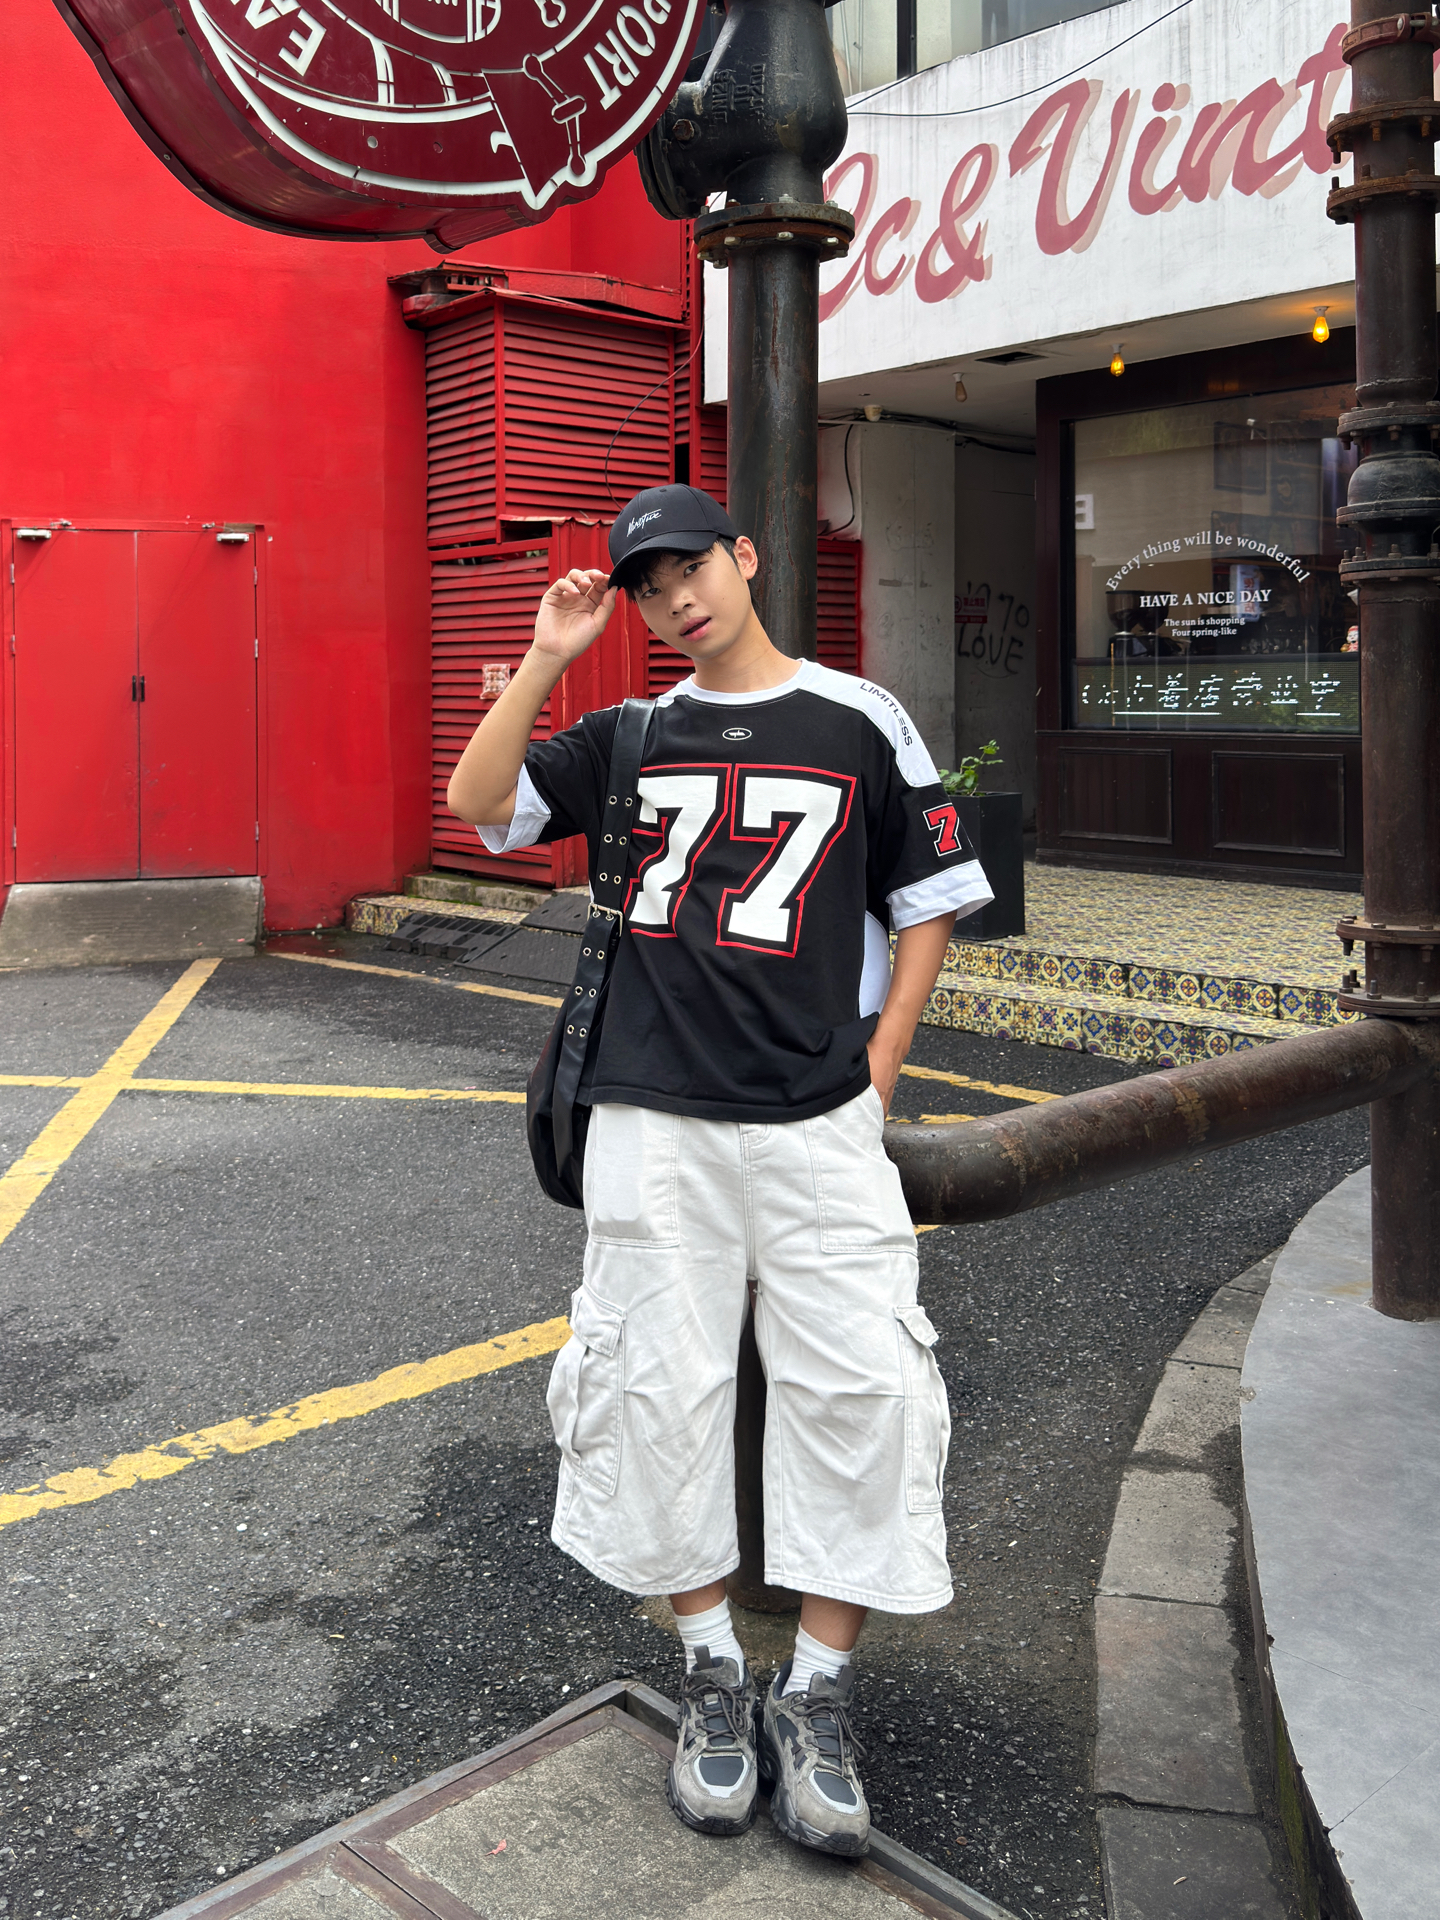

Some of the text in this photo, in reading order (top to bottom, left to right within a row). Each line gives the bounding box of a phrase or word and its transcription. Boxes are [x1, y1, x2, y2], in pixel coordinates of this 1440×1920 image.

[231, 0, 327, 77] EA
[915, 143, 999, 304] &
[1009, 22, 1353, 256] Vint
[1105, 531, 1311, 591] Every thing will be wonderful
[1139, 589, 1272, 608] HAVE A NICE DAY
[1164, 616, 1246, 627] The sun is shopping
[1172, 626, 1237, 638] Four spring-like
[859, 682, 913, 747] LIMITLESS
[923, 802, 961, 857] 7
[624, 766, 855, 955] 77
